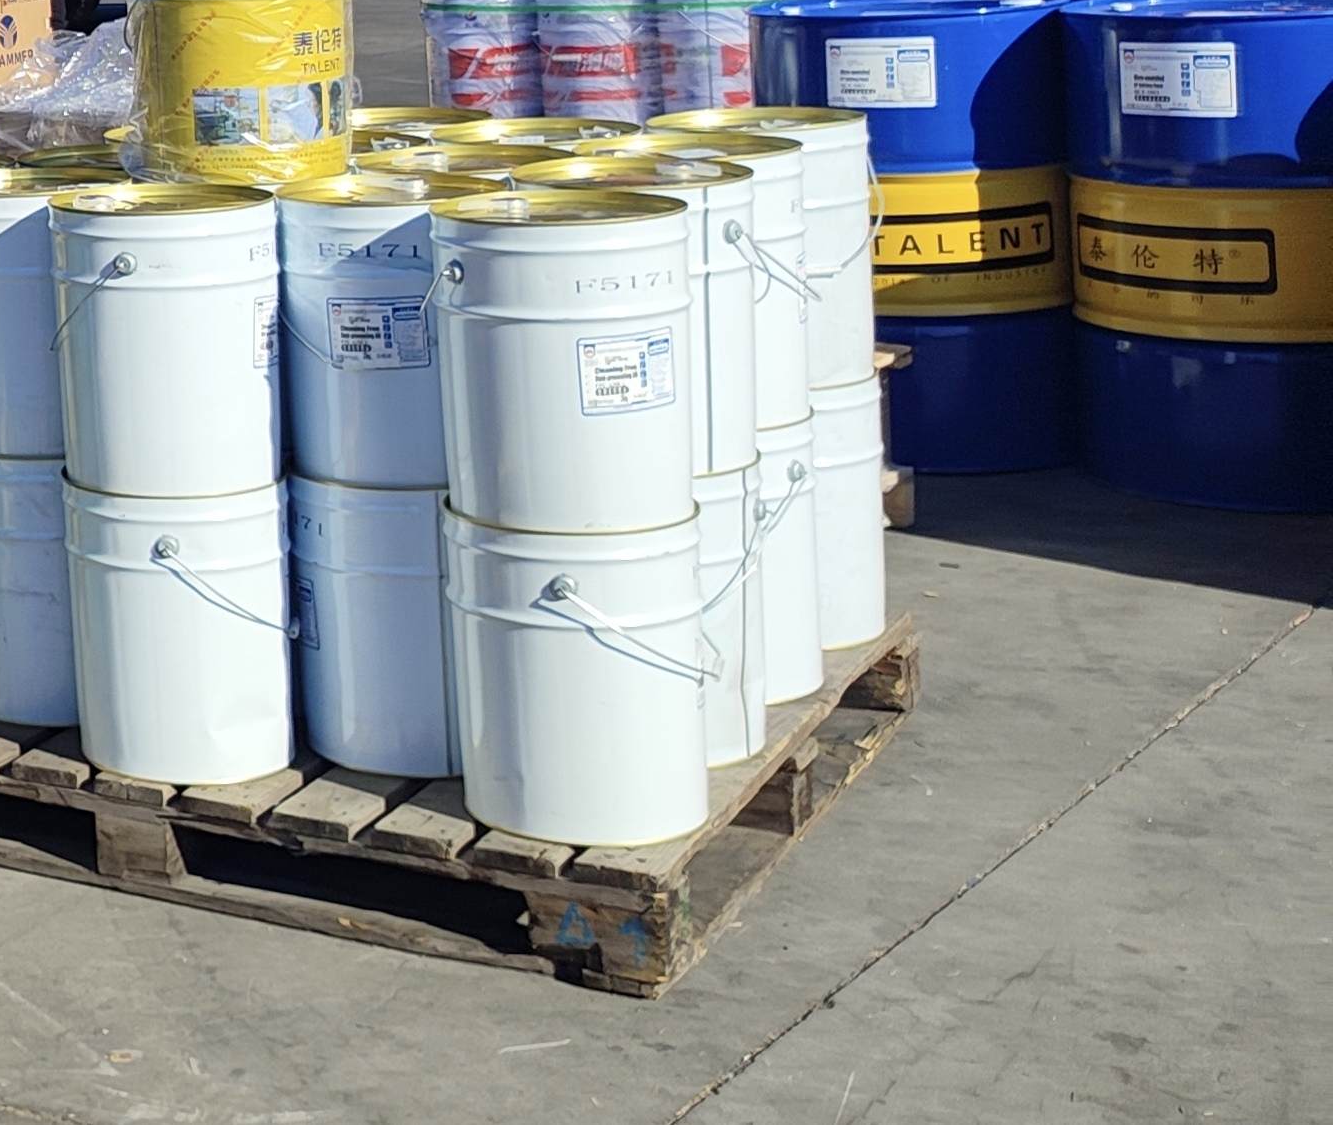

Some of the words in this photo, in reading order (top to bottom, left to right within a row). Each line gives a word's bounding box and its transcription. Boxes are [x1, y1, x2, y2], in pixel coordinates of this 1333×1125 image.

[301, 58, 340, 76] TALENT
[872, 223, 1044, 256] TALENT
[318, 242, 422, 259] F5171
[576, 270, 673, 294] F5171
